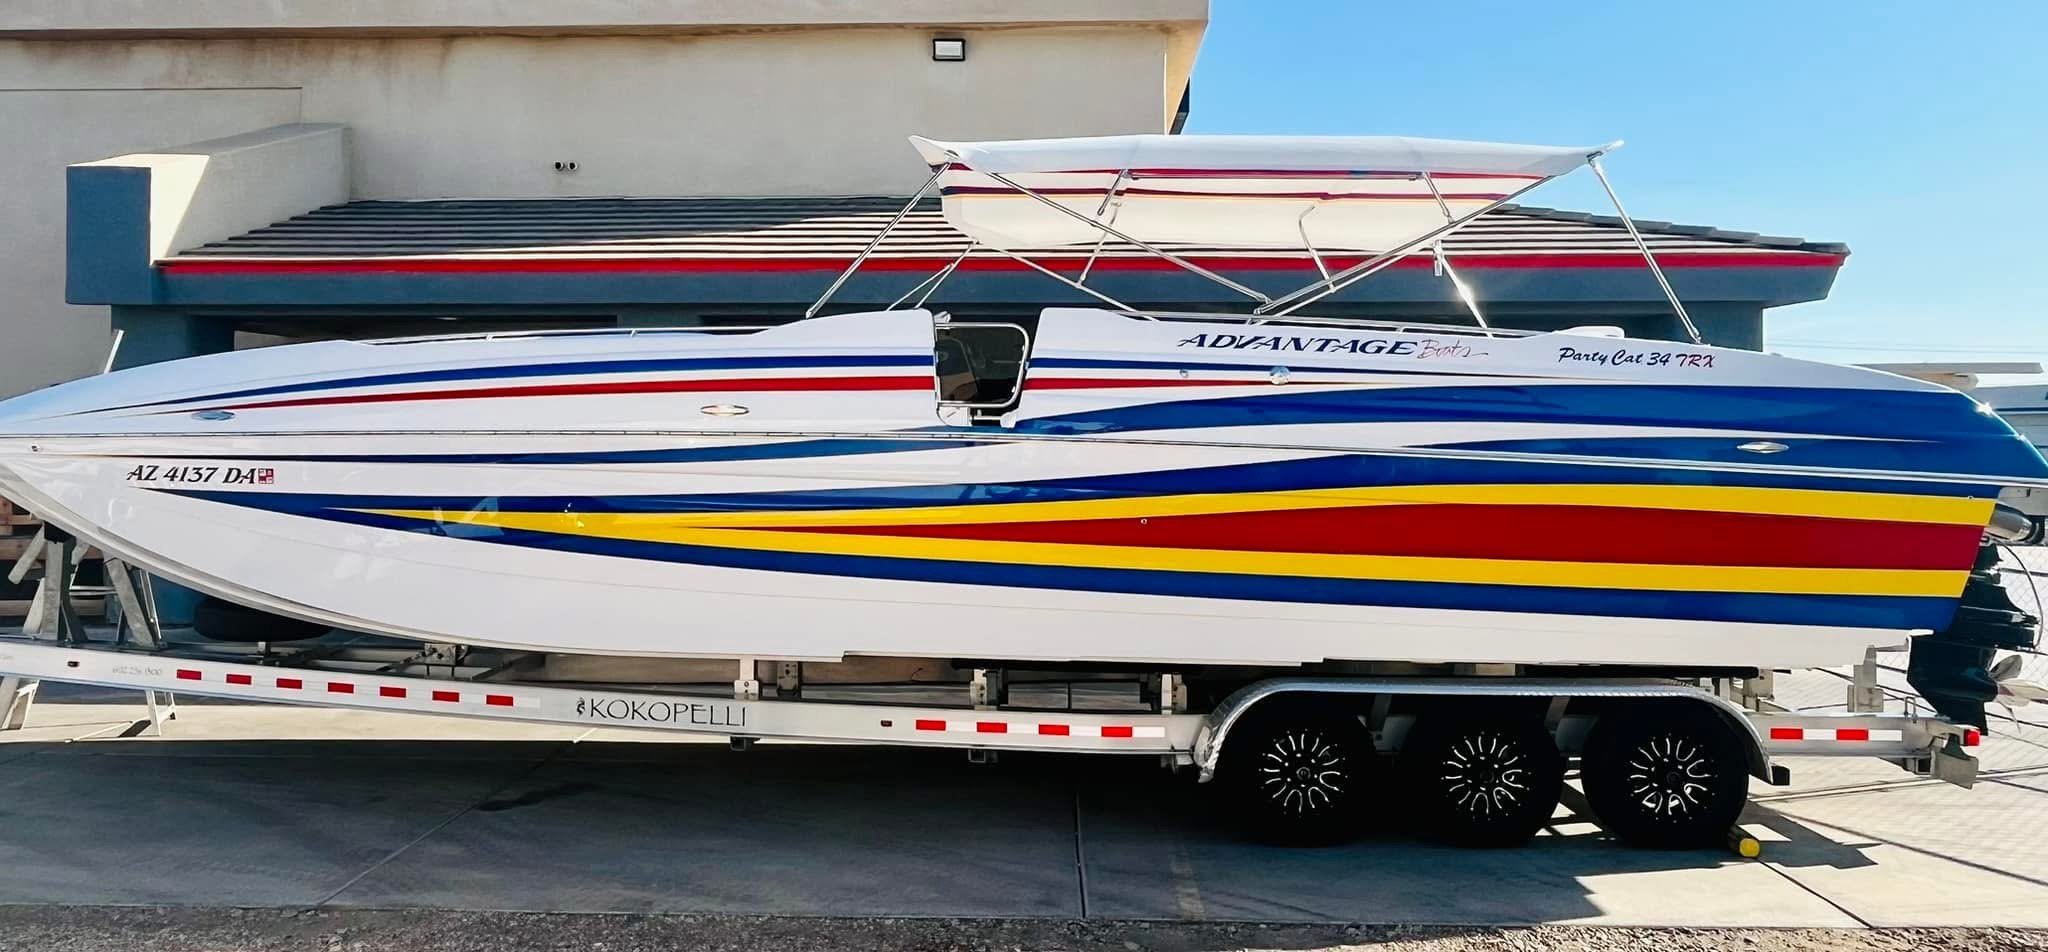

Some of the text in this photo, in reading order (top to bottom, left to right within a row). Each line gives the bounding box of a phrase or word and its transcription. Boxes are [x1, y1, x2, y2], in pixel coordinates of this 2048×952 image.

[1177, 333, 1488, 359] ADVANTAGE Boats
[1558, 347, 1716, 368] Party Cat 34 TRX
[126, 465, 160, 481] AZ
[163, 466, 218, 483] 4137
[222, 467, 257, 484] DA
[590, 698, 746, 727] KOKOPELLI
